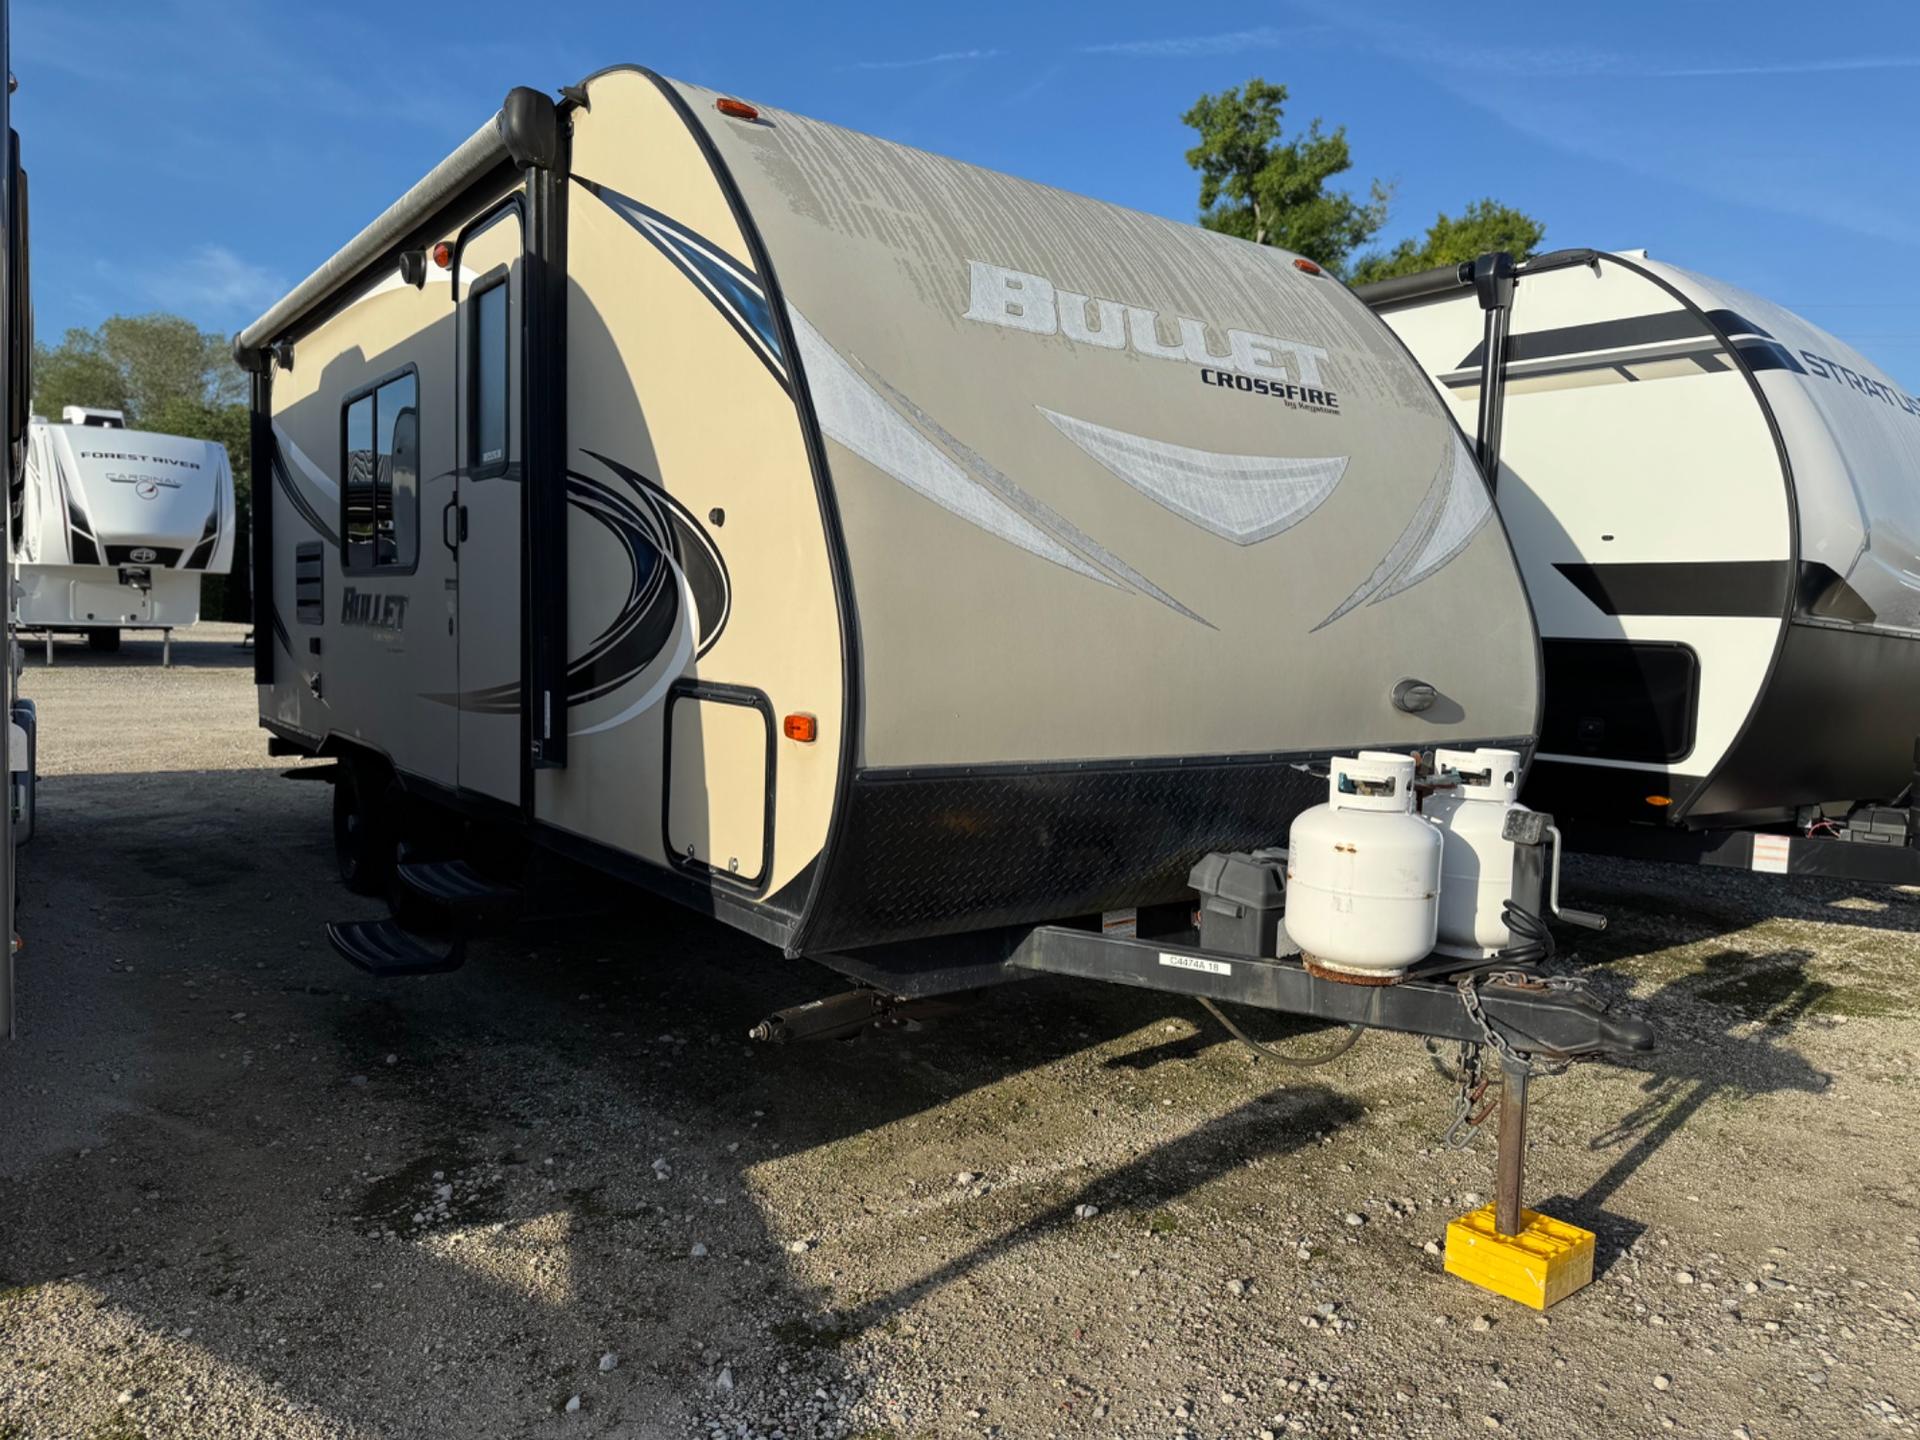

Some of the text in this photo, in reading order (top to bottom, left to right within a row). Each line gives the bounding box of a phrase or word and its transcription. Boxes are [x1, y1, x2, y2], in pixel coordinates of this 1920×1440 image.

[963, 259, 1330, 388] BULLET
[1200, 368, 1339, 408] CROSSFIRE
[81, 451, 200, 470] FOREST RIVER
[105, 472, 178, 484] CARDINAL
[341, 586, 410, 630] BULLET
